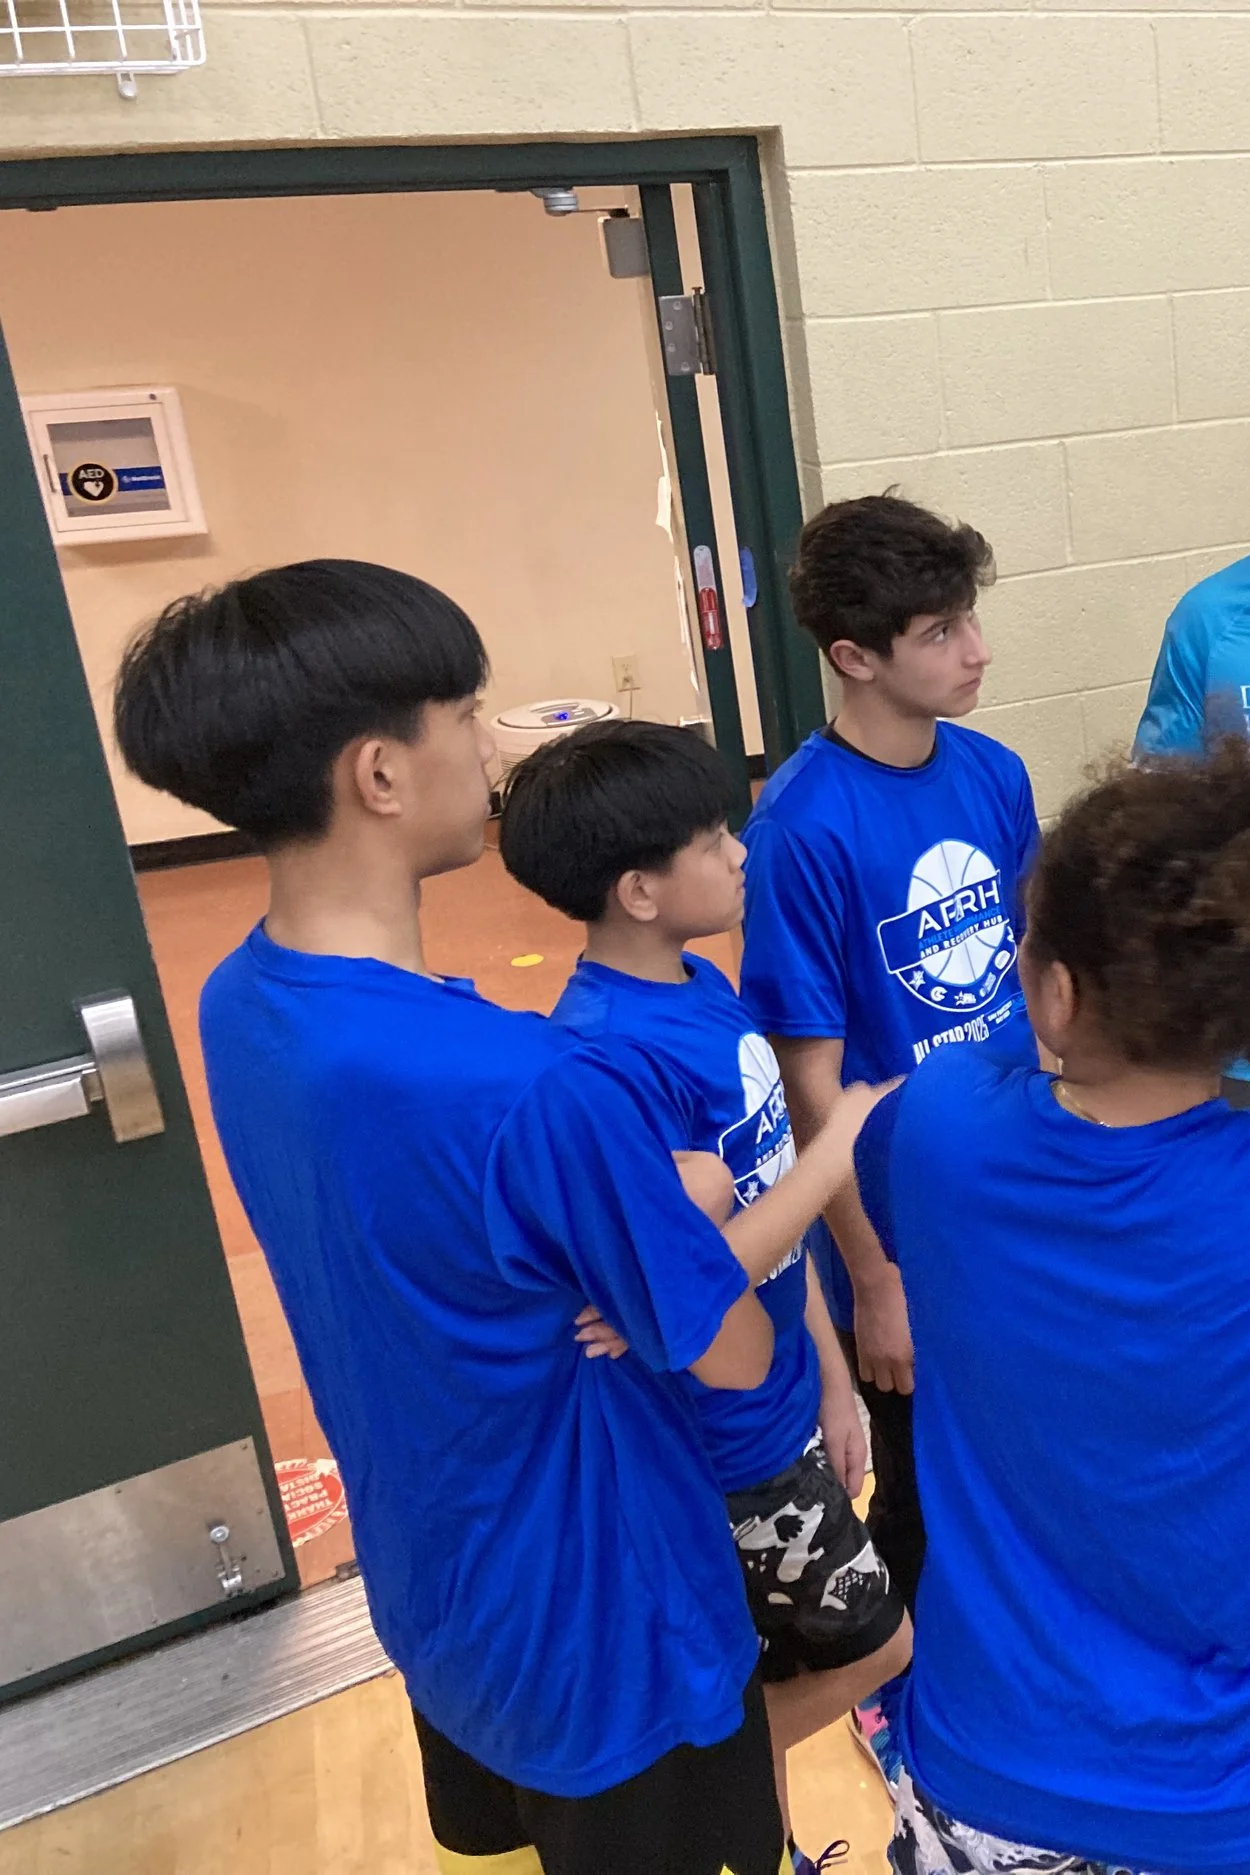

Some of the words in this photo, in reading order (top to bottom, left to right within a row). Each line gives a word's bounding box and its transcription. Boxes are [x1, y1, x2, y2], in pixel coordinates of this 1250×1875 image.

[78, 468, 105, 480] AED
[920, 944, 940, 958] AND
[983, 914, 1003, 929] HUB
